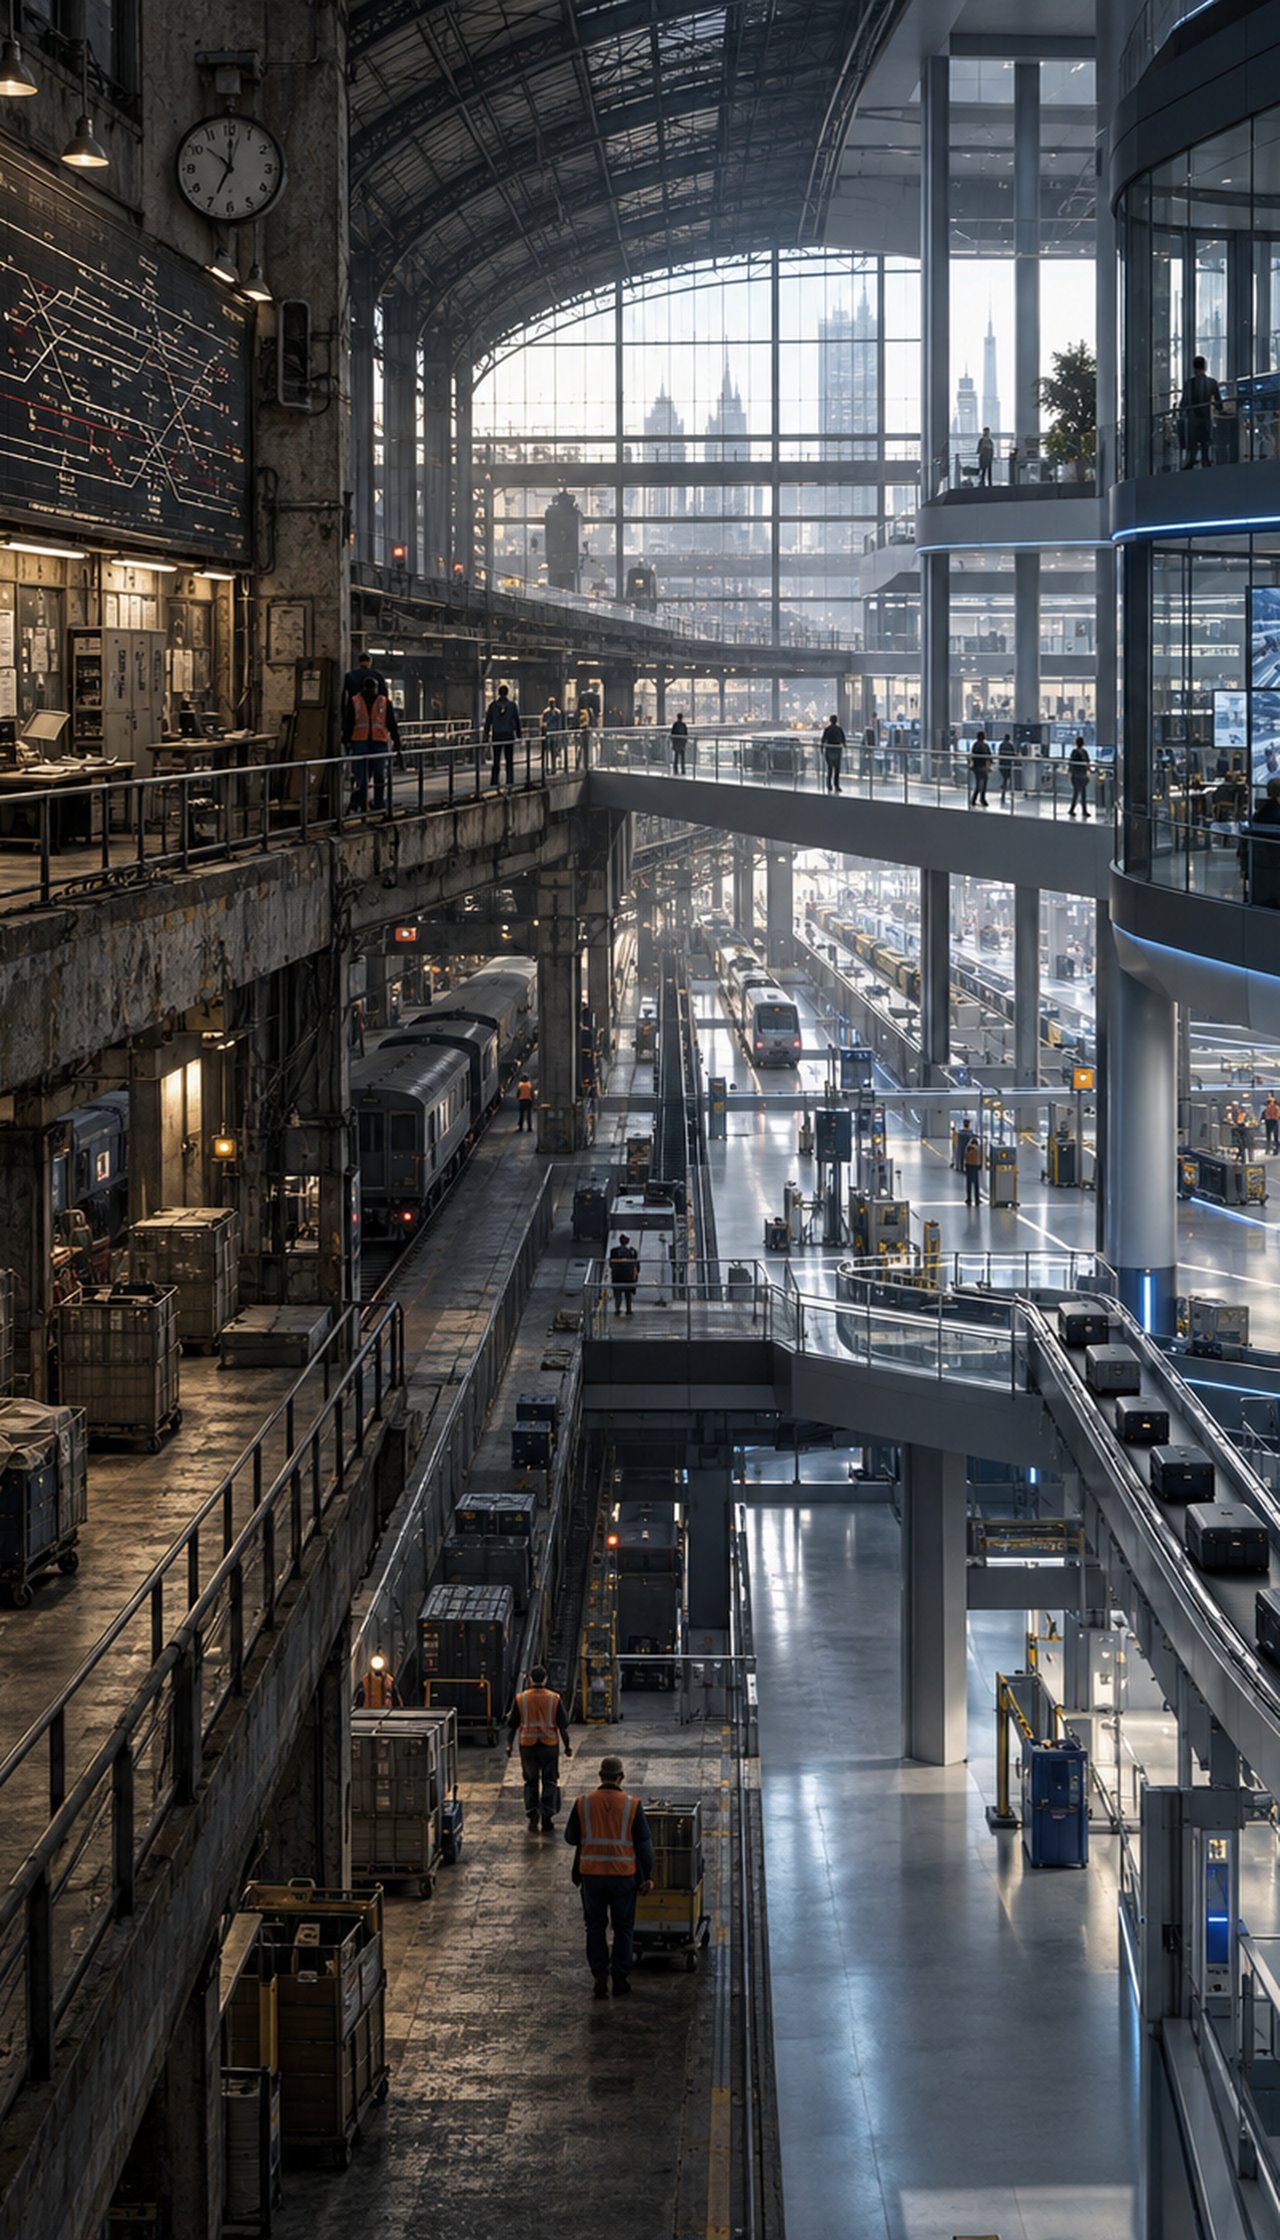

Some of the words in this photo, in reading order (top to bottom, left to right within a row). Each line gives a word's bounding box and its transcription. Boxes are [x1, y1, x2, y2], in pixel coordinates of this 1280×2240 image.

[190, 145, 203, 155] 10
[259, 144, 268, 155] 2
[264, 164, 272, 174] 3
[207, 196, 214, 208] 7
[226, 201, 234, 213] 6
[245, 196, 254, 209] 5
